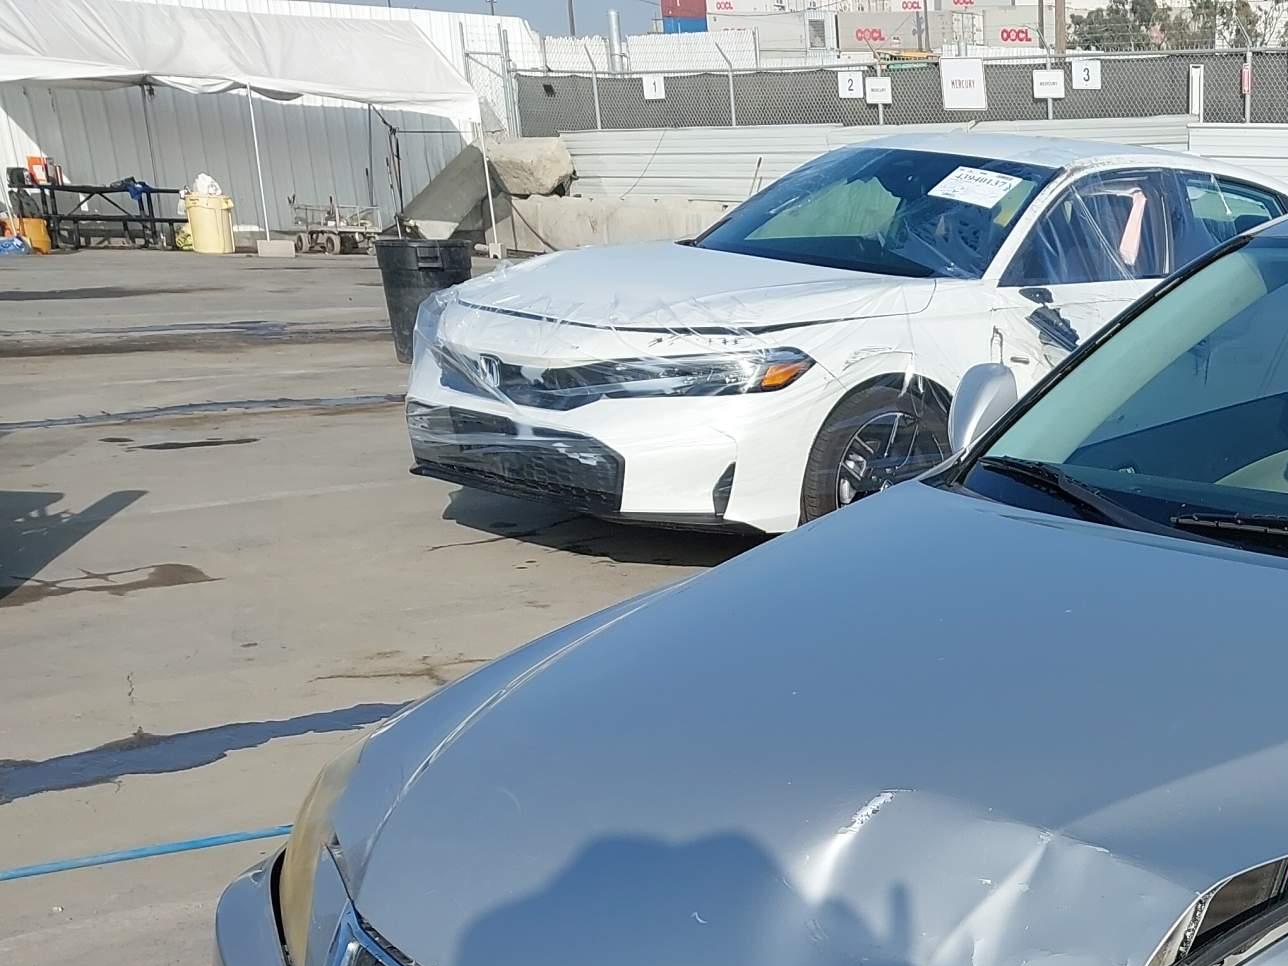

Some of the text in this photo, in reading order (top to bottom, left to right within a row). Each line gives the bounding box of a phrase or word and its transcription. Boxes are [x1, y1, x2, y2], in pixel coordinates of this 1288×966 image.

[1001, 28, 1032, 42] OOCL
[1083, 67, 1090, 82] 3
[652, 79, 657, 93] 1
[848, 78, 854, 91] 2
